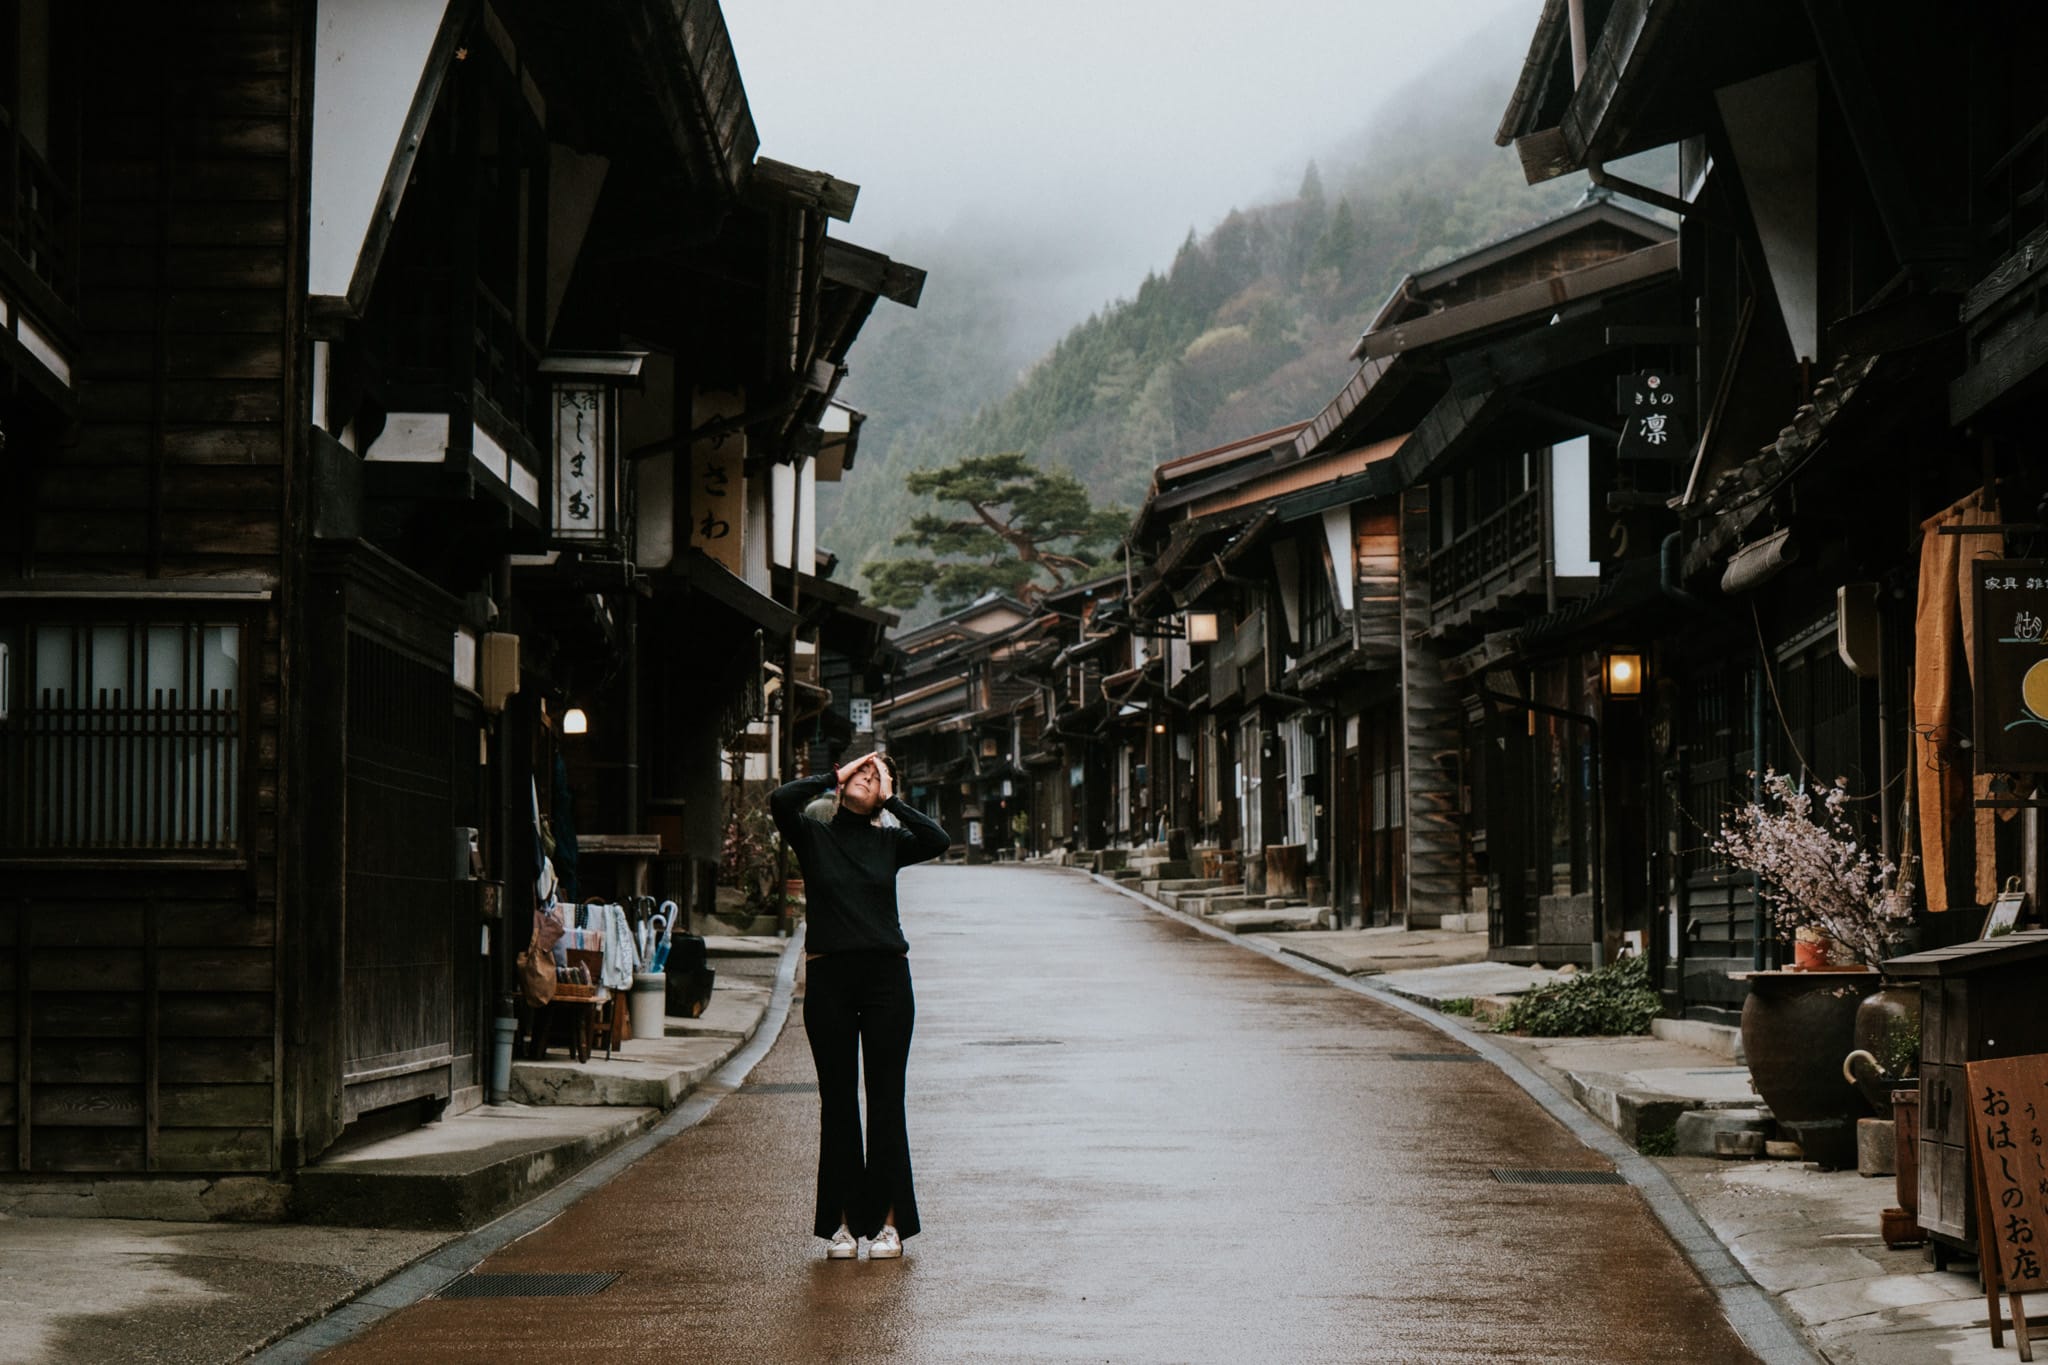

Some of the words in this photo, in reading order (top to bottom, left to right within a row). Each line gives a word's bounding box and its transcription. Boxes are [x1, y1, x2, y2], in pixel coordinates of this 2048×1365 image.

[1634, 392, 1674, 405] きもの
[1984, 576, 2020, 590] 家具
[1982, 1087, 2041, 1281] おはしのお店
